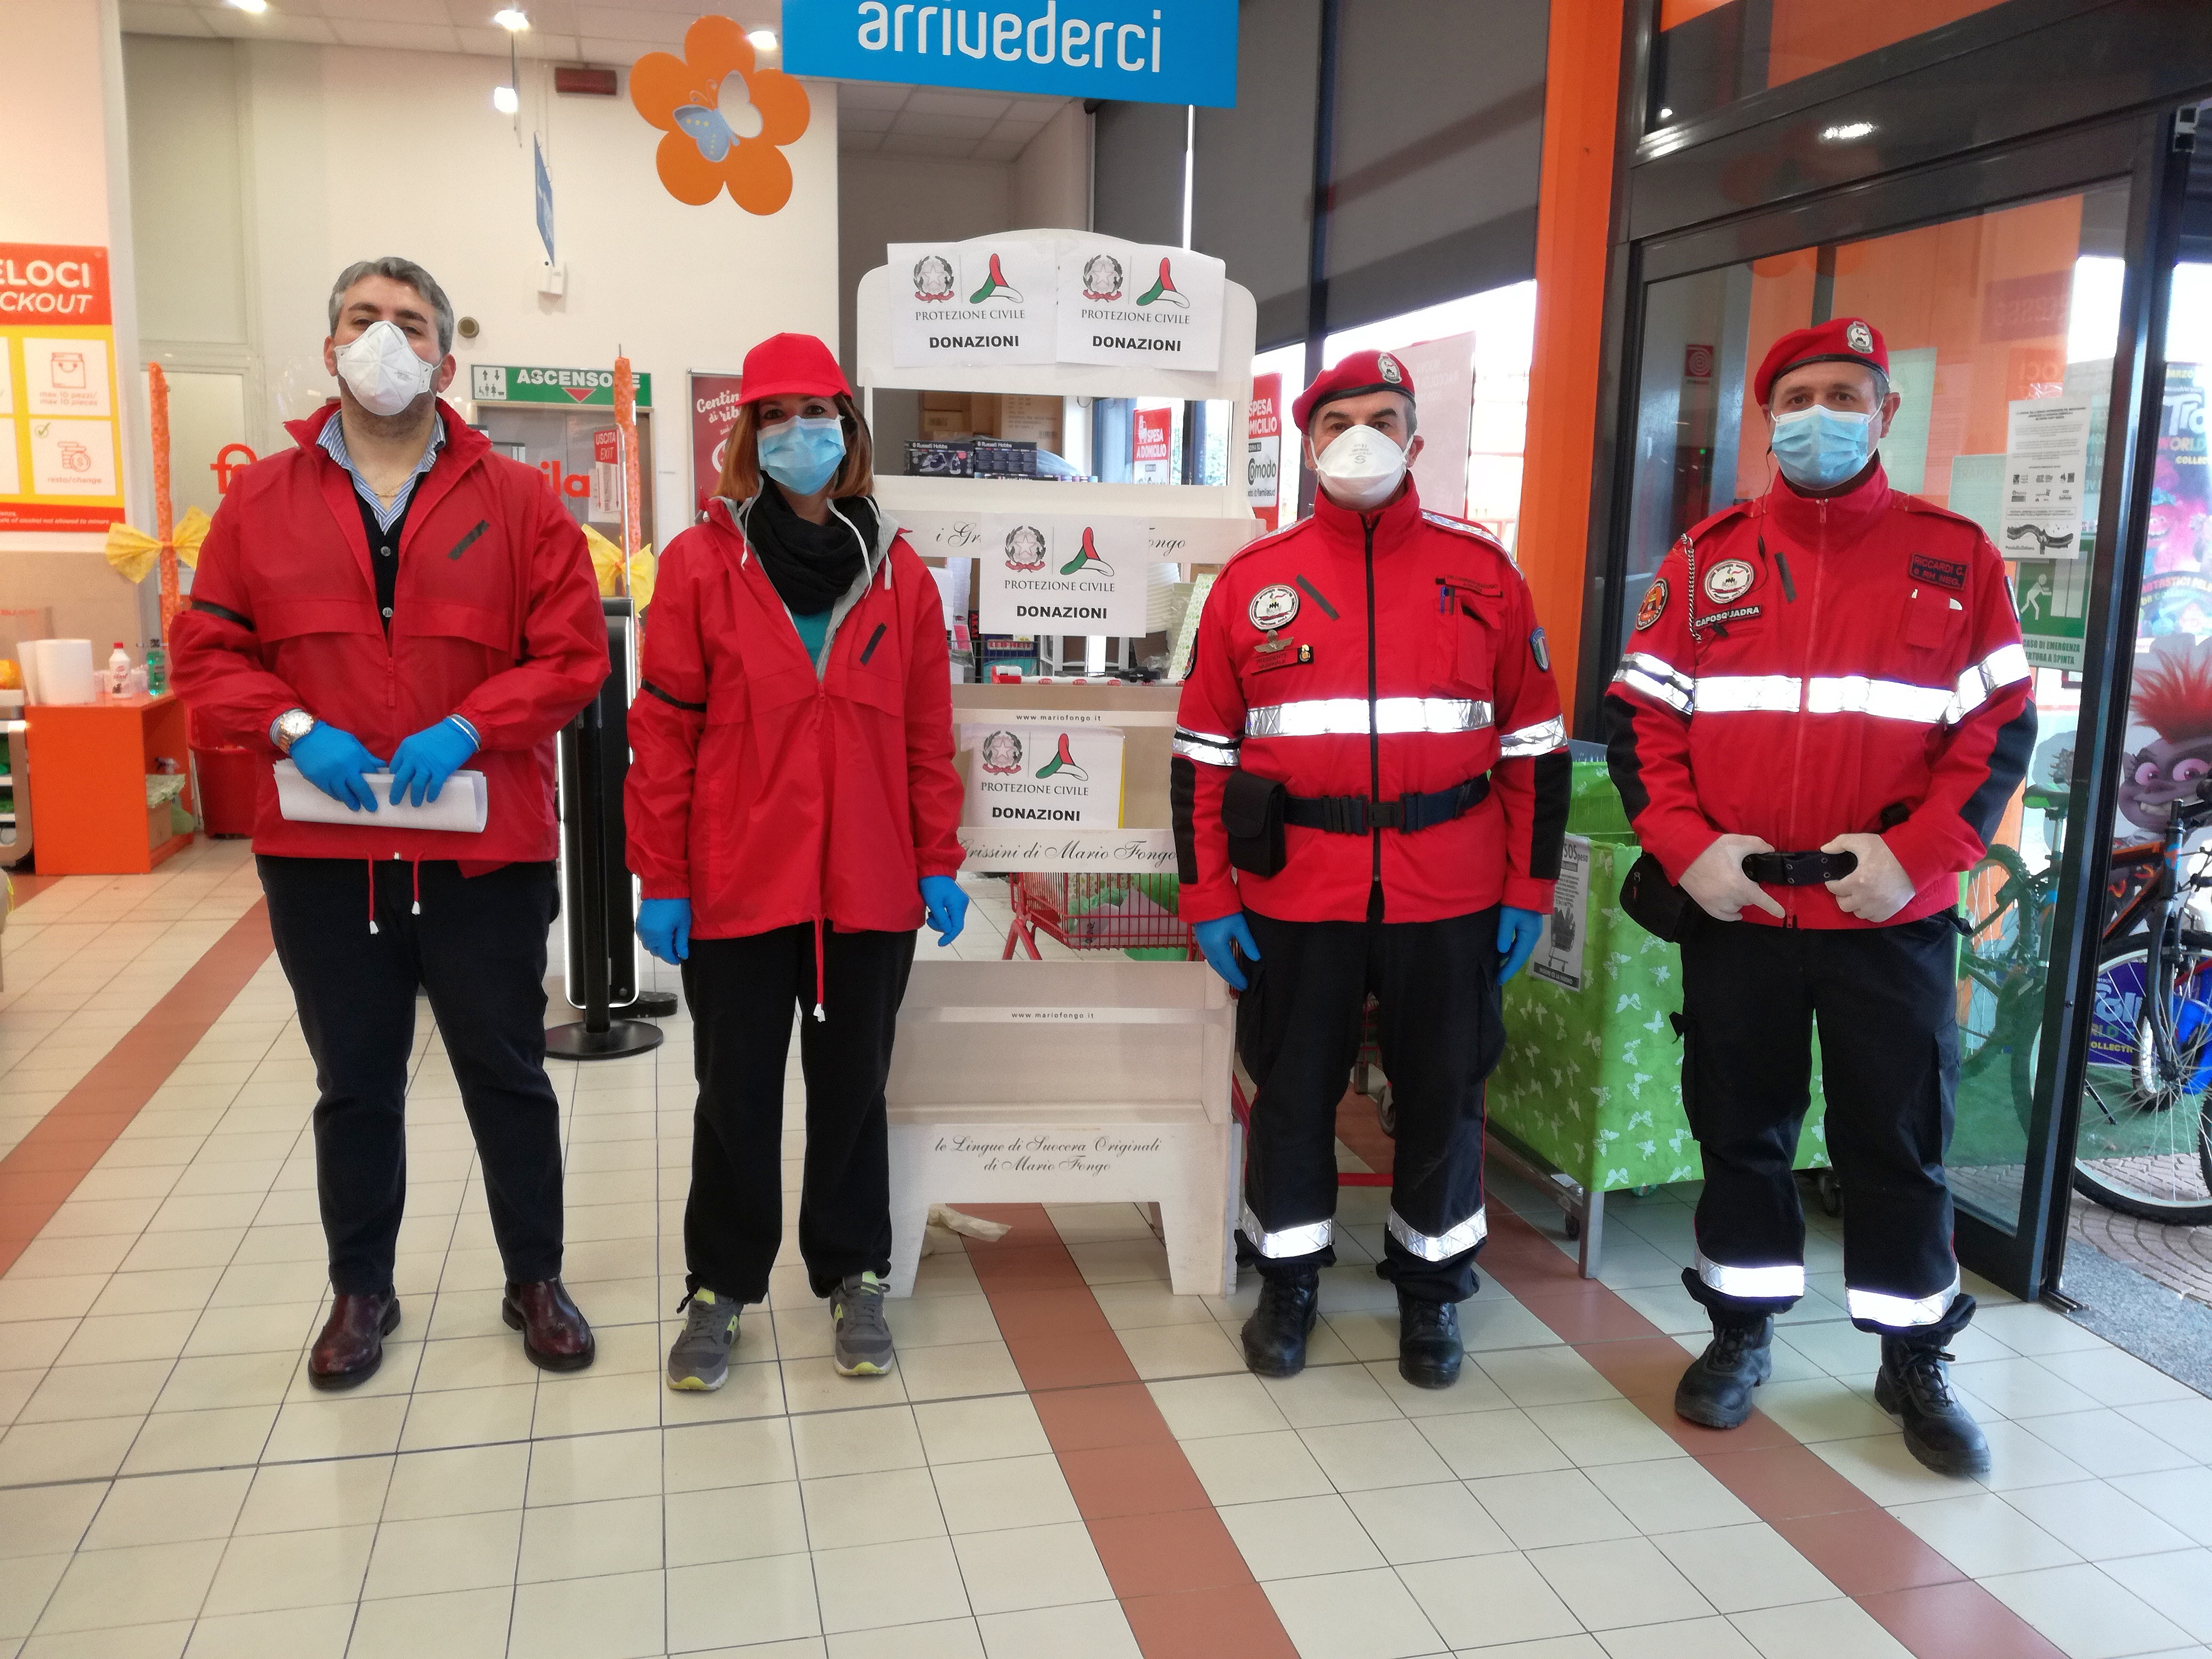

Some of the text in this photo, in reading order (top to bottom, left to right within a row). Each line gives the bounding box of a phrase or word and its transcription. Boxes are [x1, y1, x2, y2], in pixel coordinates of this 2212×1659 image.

[858, 0, 1161, 72] arrivederci
[916, 309, 1025, 321] PROTEZIONE CIVILE
[1082, 308, 1190, 324] PROTEZIONE CIVILE
[929, 335, 1019, 349] DONAZIONI
[1093, 335, 1181, 352] DONAZIONI
[517, 370, 641, 389] ASCENSOE
[1249, 397, 1272, 417] SPESA
[596, 432, 616, 445] USCITA
[1147, 429, 1164, 443] SPESA
[601, 447, 614, 460] EXIT
[1142, 443, 1167, 458] DOMICILIO
[1004, 580, 1115, 592] PROTEZIONE CIVILE
[1017, 606, 1107, 619] DONAZIONI
[2046, 641, 2080, 653] EMERGENZA
[2048, 653, 2053, 663] A
[2053, 654, 2075, 665] SPINTA
[981, 782, 1088, 795] PROTEZIONE CIVILE
[993, 807, 1080, 822] DONAZIONI
[1024, 842, 1042, 859] di
[1044, 840, 1109, 860] Mario
[1113, 841, 1177, 868] Fongo
[935, 1135, 1162, 1158] le Lingue di Suocera Originali
[984, 1155, 1111, 1177] di Mario Fongo
